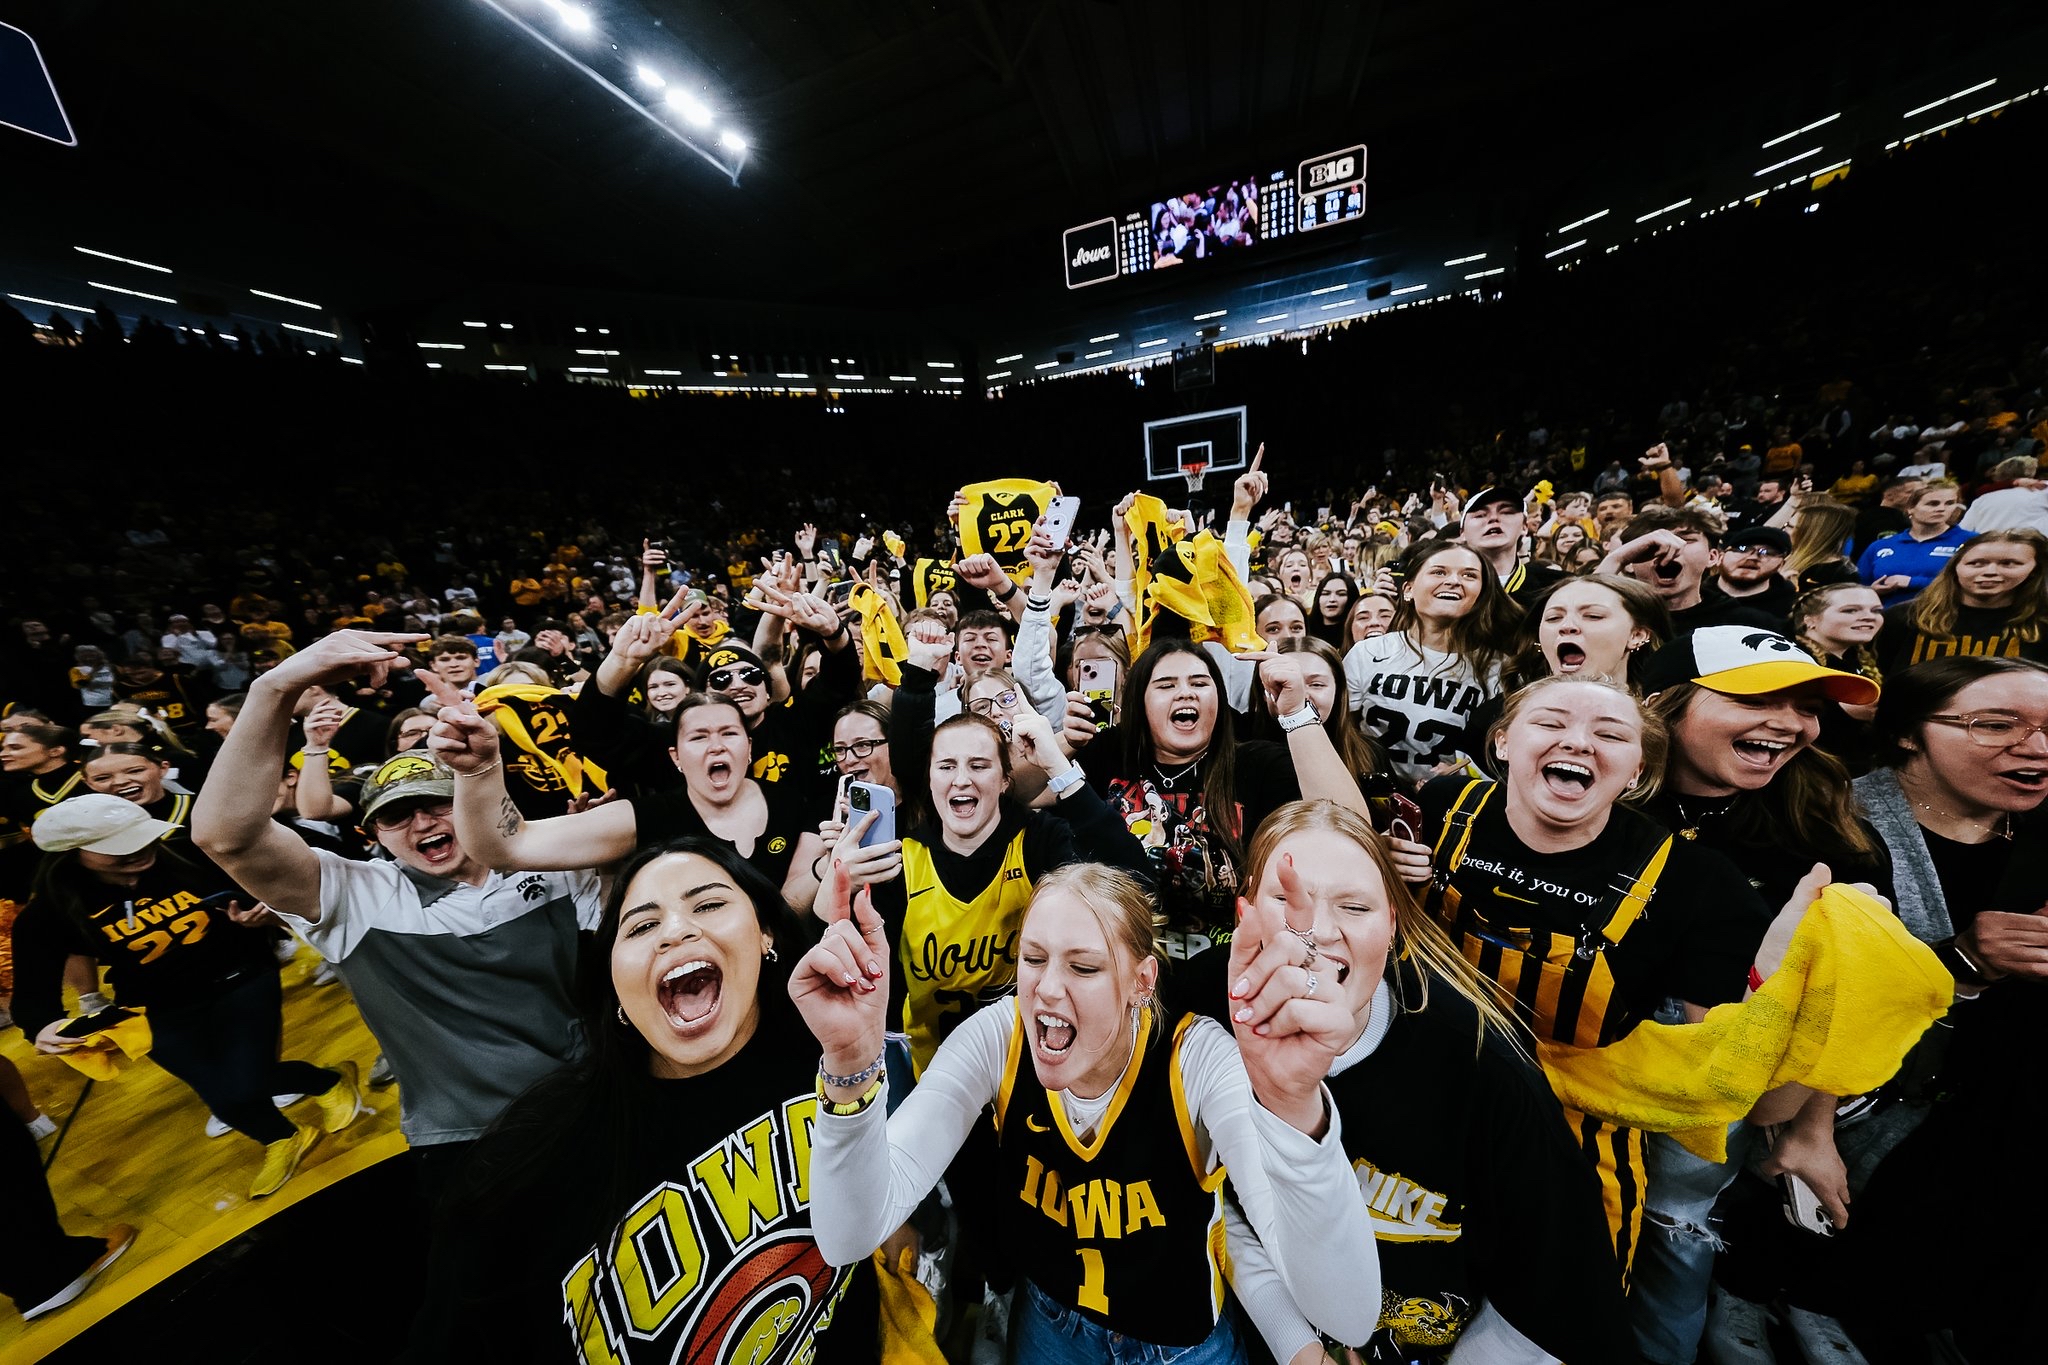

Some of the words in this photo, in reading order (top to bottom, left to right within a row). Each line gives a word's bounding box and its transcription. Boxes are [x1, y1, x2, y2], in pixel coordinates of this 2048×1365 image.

[1072, 245, 1111, 268] Iowa
[988, 519, 1032, 553] 22
[990, 508, 1025, 521] CLARK
[928, 574, 956, 591] 22
[1461, 853, 1505, 876] break
[1507, 868, 1525, 884] it,
[1528, 878, 1570, 898] you
[101, 891, 202, 942] IOWA
[127, 911, 210, 965] 22
[1164, 929, 1211, 960] ED
[1020, 1155, 1166, 1239] IOWA
[1354, 1163, 1448, 1228] NIKE
[1076, 1248, 1109, 1316] 1
